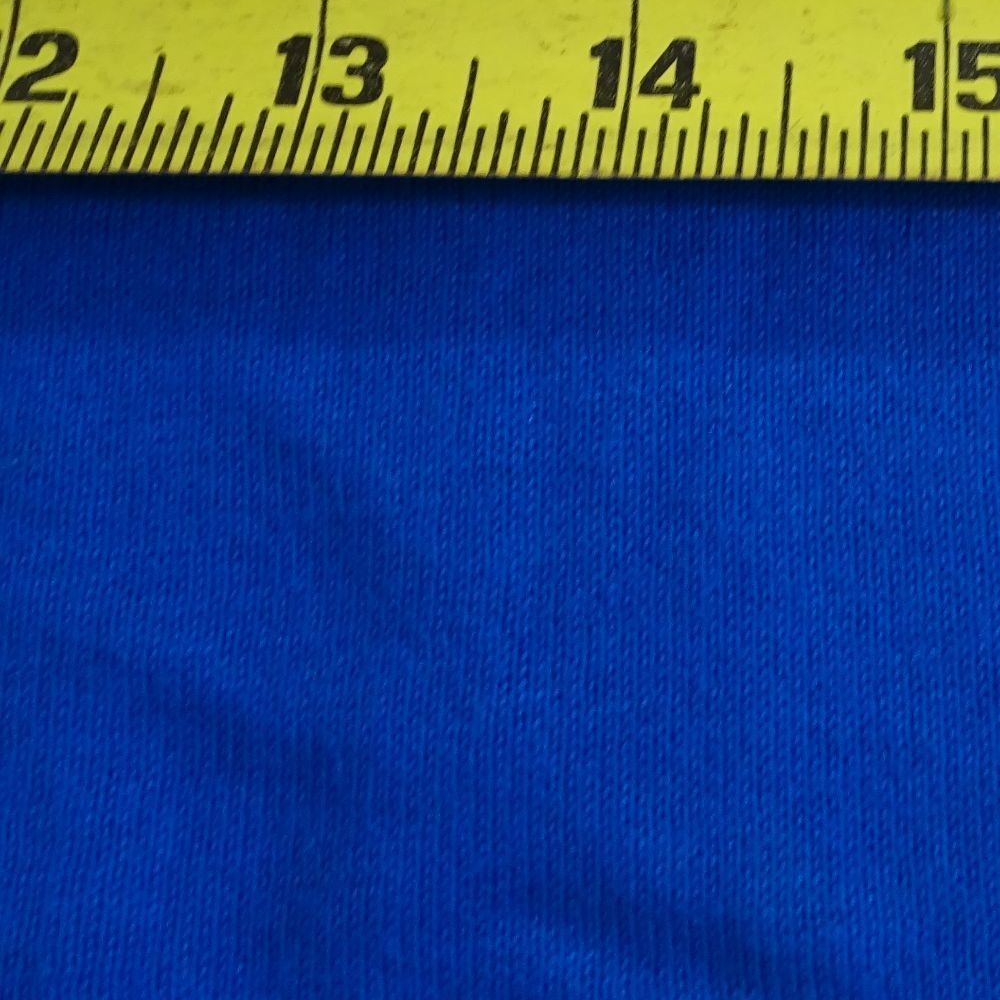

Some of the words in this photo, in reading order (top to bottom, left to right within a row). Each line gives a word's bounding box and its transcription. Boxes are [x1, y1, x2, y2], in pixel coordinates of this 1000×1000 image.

[0, 30, 79, 102] 2
[274, 33, 389, 106] 13
[589, 37, 701, 111] 14
